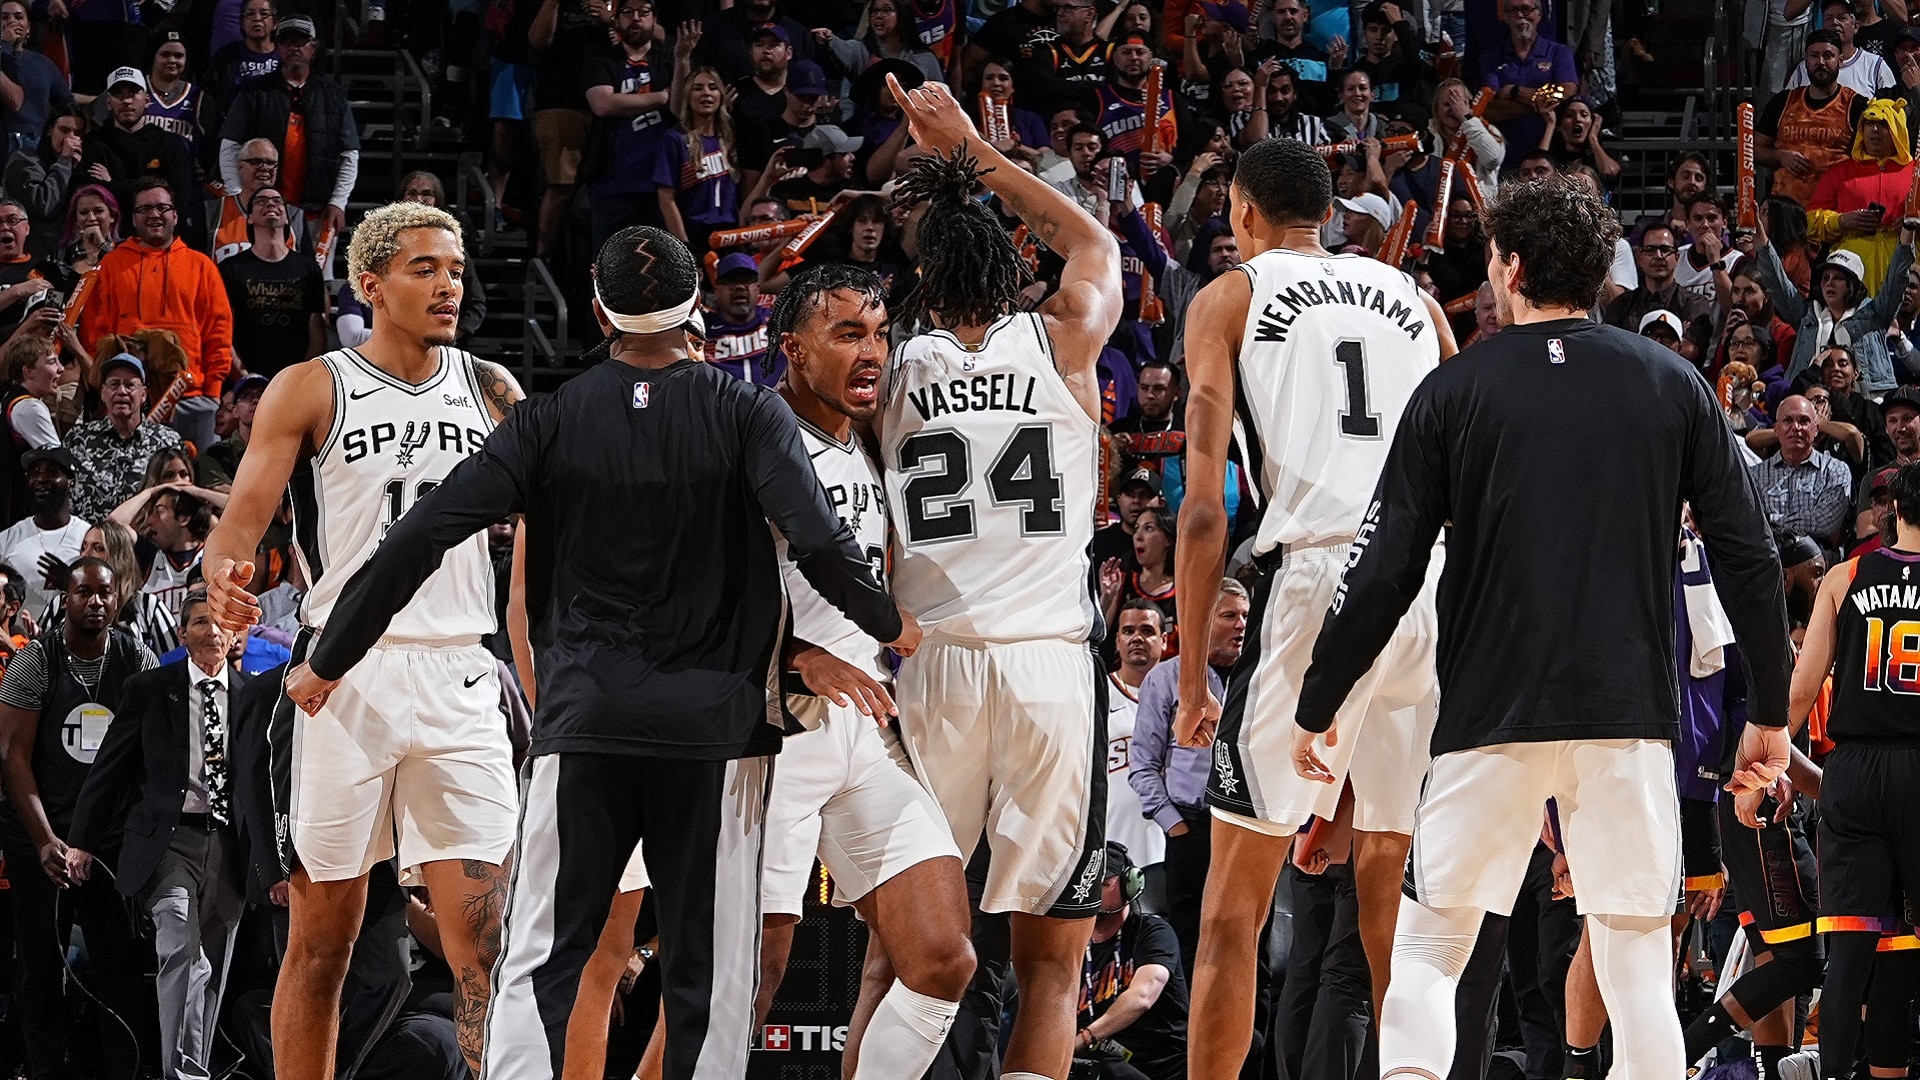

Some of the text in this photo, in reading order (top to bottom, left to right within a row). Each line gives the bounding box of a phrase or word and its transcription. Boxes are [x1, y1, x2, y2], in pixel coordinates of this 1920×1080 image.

[1336, 143, 1357, 154] SUN
[1743, 108, 1754, 171] GO SUNS
[696, 151, 729, 180] SUN
[720, 227, 772, 247] GO SUNS
[1254, 280, 1425, 342] WEMBANYAMA
[715, 327, 769, 360] SUNS
[442, 393, 473, 409] Self.
[907, 373, 1038, 422] VASSELL
[1331, 336, 1383, 441] 1
[343, 420, 486, 469] SPURS
[382, 478, 443, 540] 1
[826, 482, 886, 531] PUR
[895, 422, 1067, 548] 24
[1332, 500, 1382, 616] SPURS
[1863, 617, 1920, 696] 18
[793, 1025, 850, 1052] TIS
